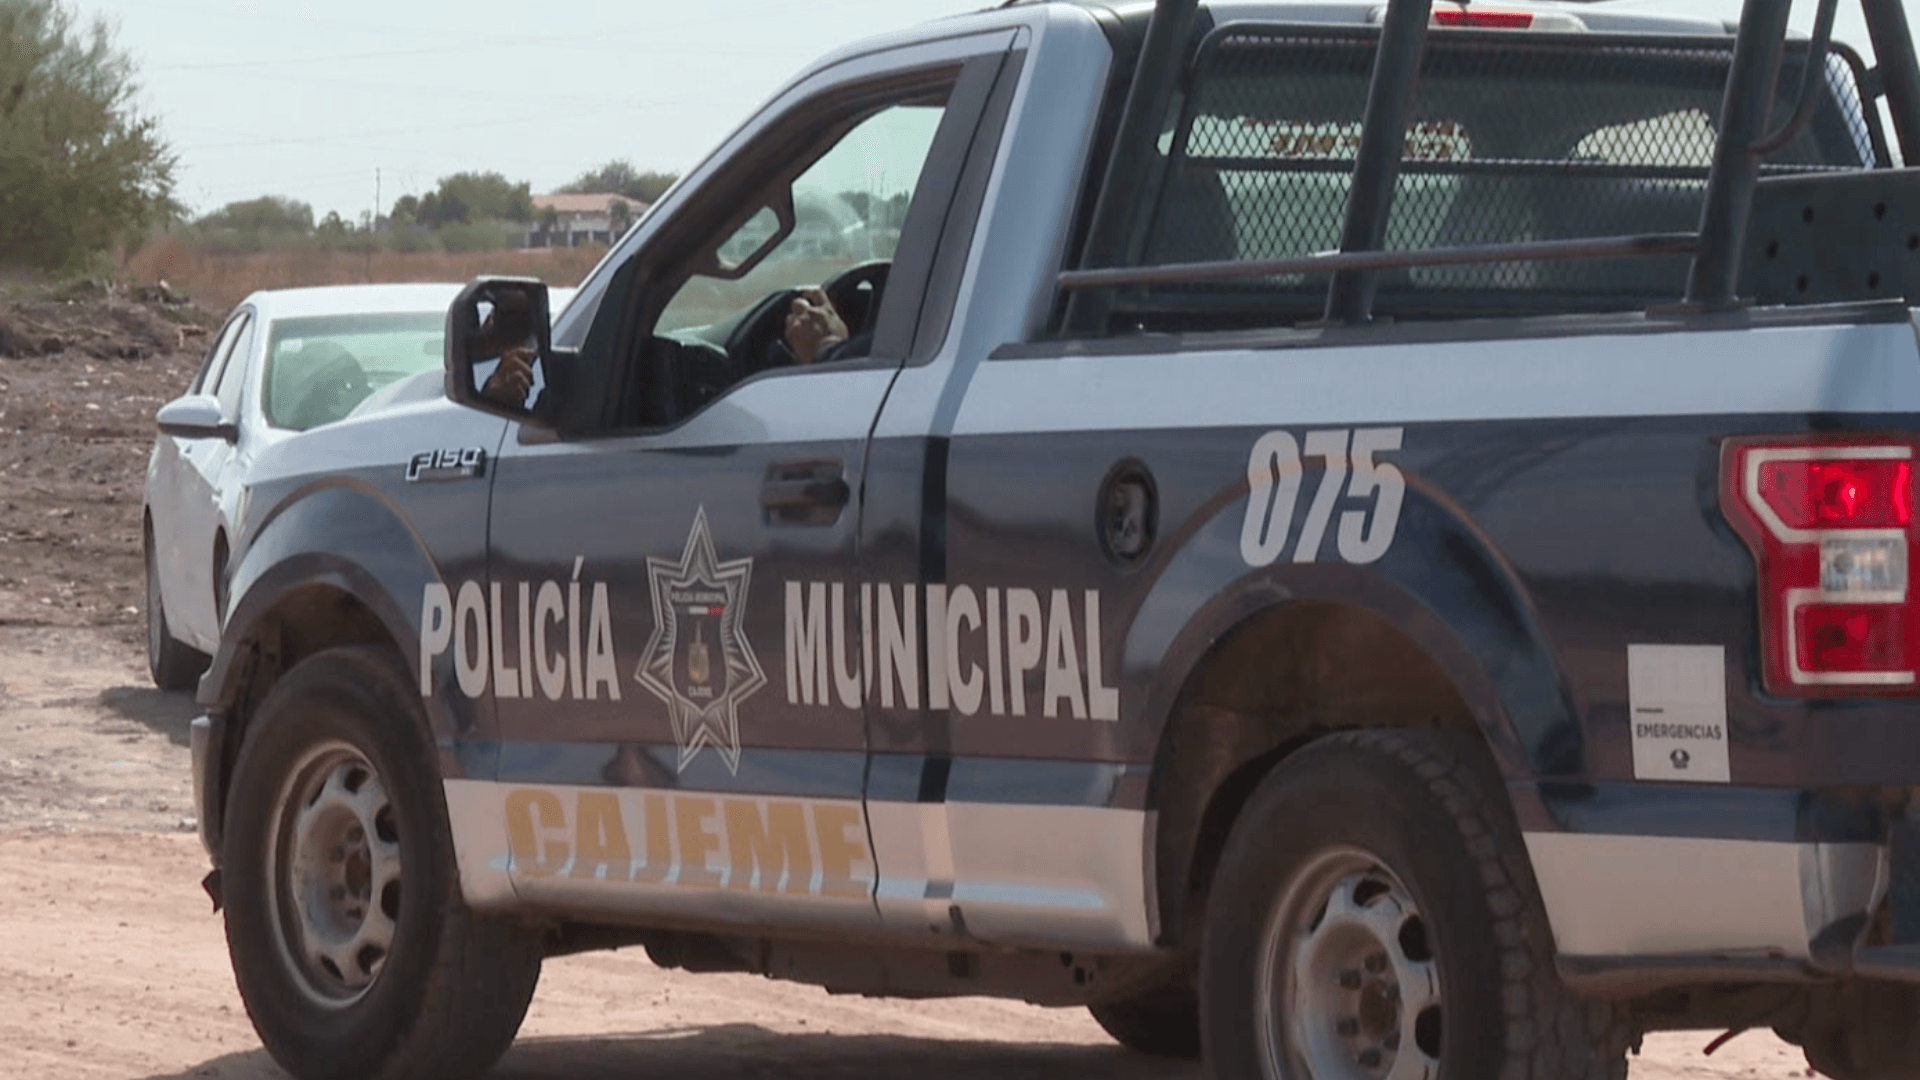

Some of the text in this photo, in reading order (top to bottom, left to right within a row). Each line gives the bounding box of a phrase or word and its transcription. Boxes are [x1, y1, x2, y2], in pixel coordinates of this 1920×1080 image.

[1240, 427, 1405, 567] 075
[420, 555, 1119, 721] POLICÍA MUNICIPAL
[1636, 723, 1722, 741] EMERGENCIAS
[505, 788, 873, 900] CAJEME
